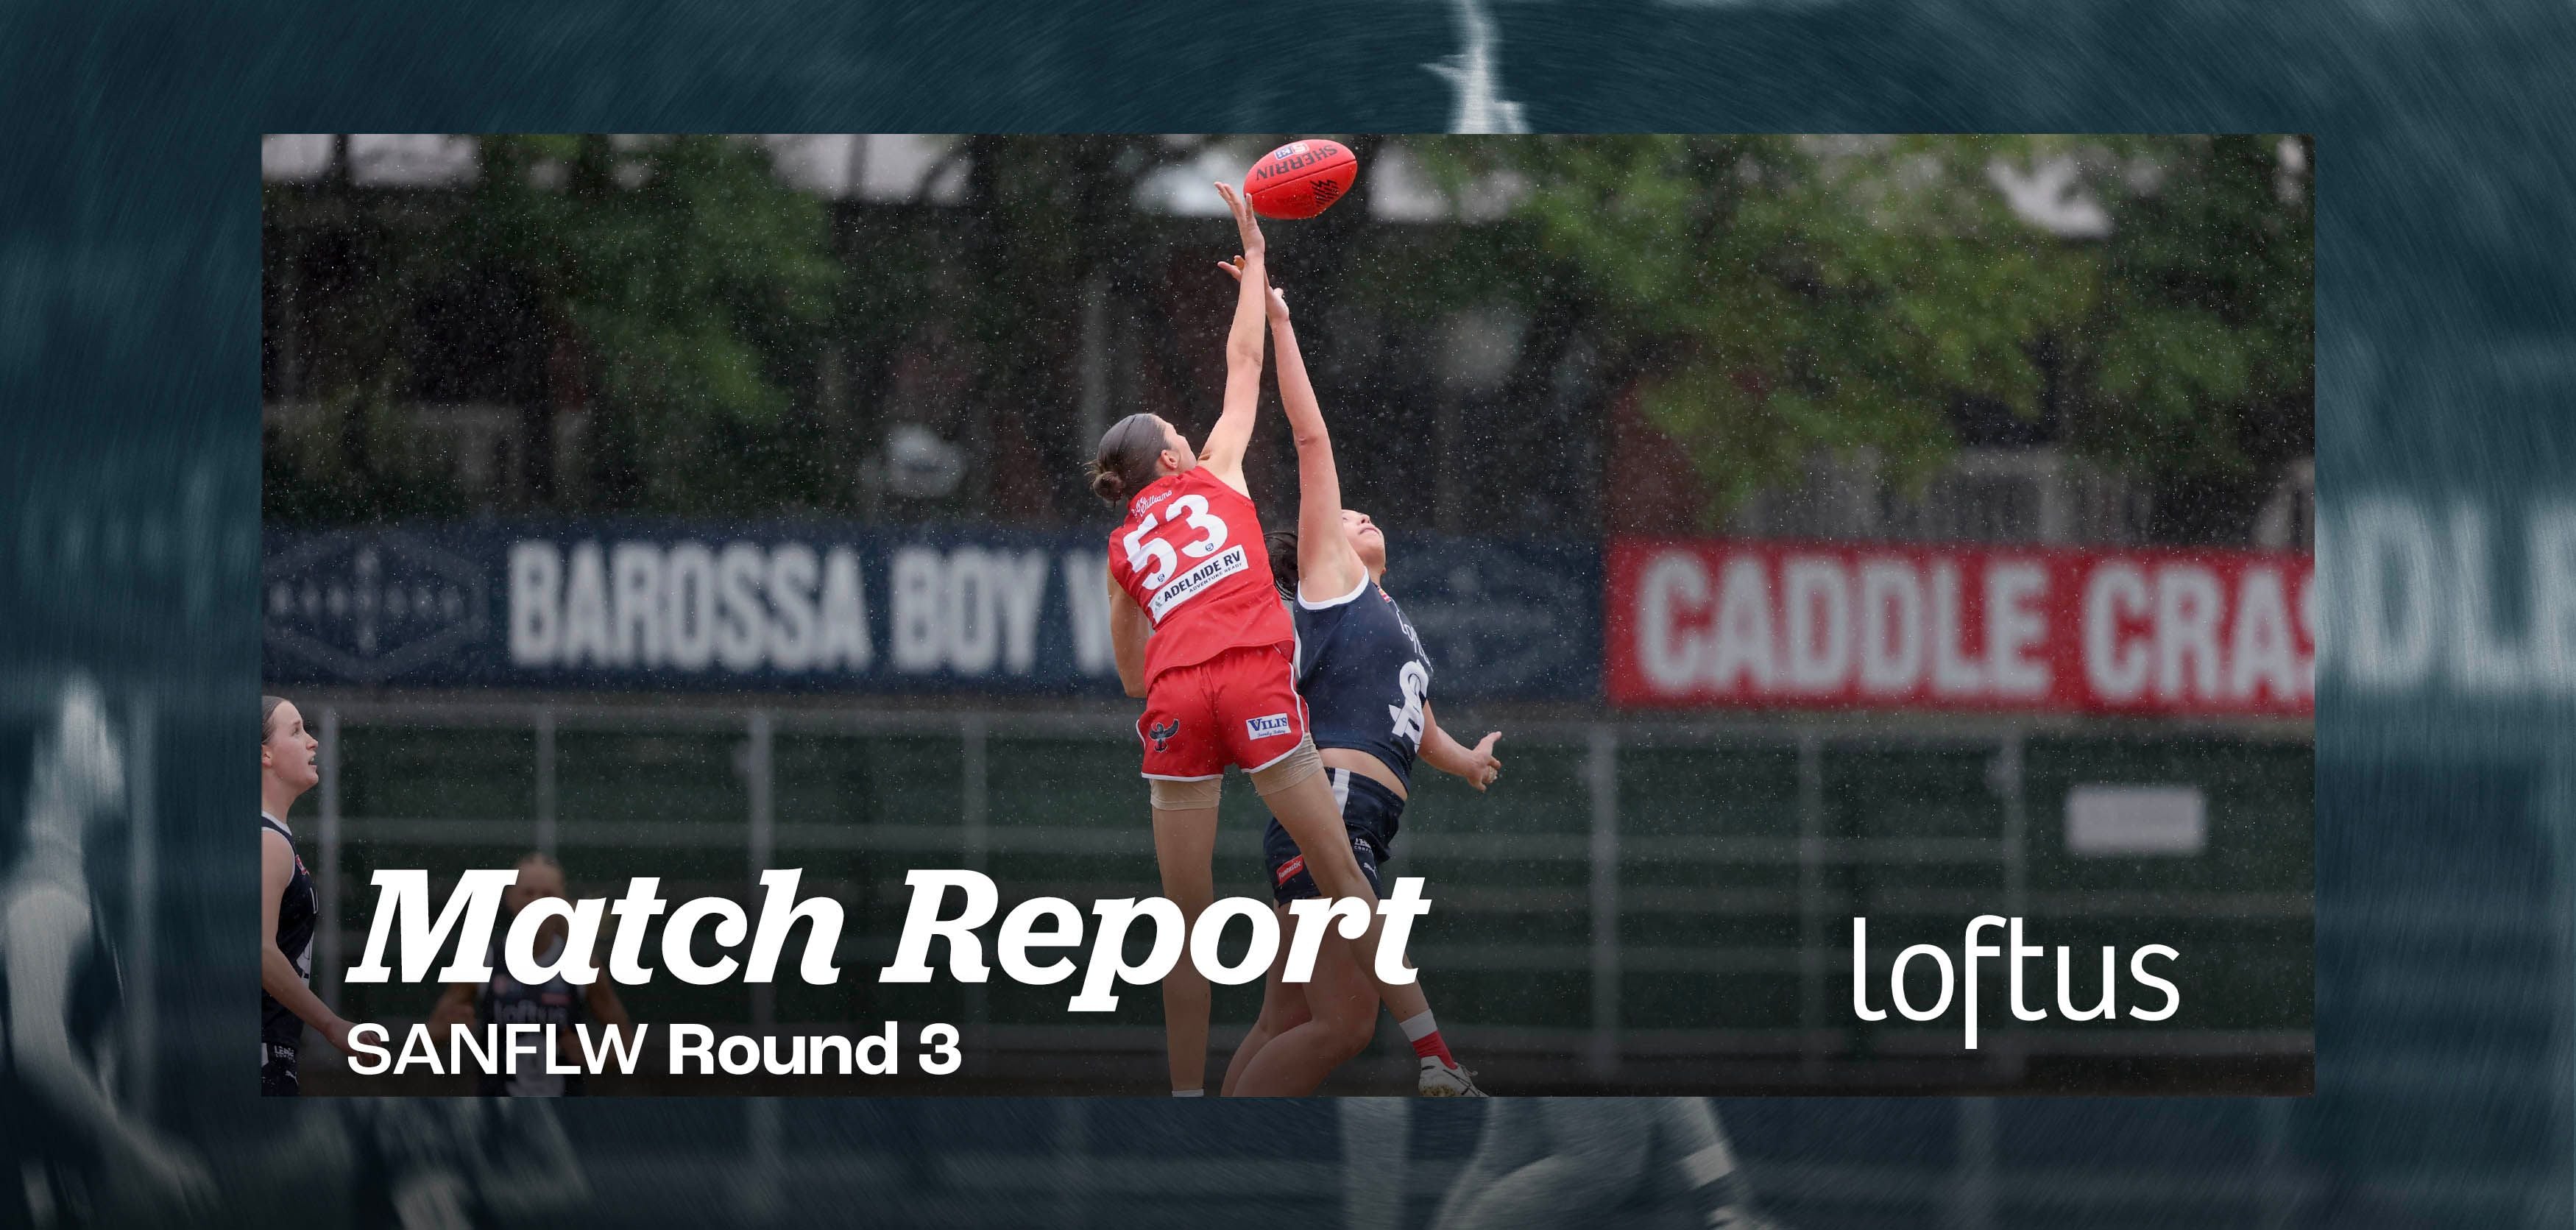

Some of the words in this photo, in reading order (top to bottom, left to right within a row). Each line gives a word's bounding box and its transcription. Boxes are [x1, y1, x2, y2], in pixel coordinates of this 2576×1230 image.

[1256, 144, 1338, 180] SHERRIN
[1123, 494, 1228, 590] 53
[1164, 560, 1222, 602] ADELAIDE
[1223, 551, 1240, 567] RV
[1189, 572, 1222, 593] ADVENTURE
[1224, 562, 1242, 573] READY
[510, 542, 874, 668] BAROSSA
[892, 547, 1048, 671] BOY
[1637, 551, 2053, 693] CADDLE
